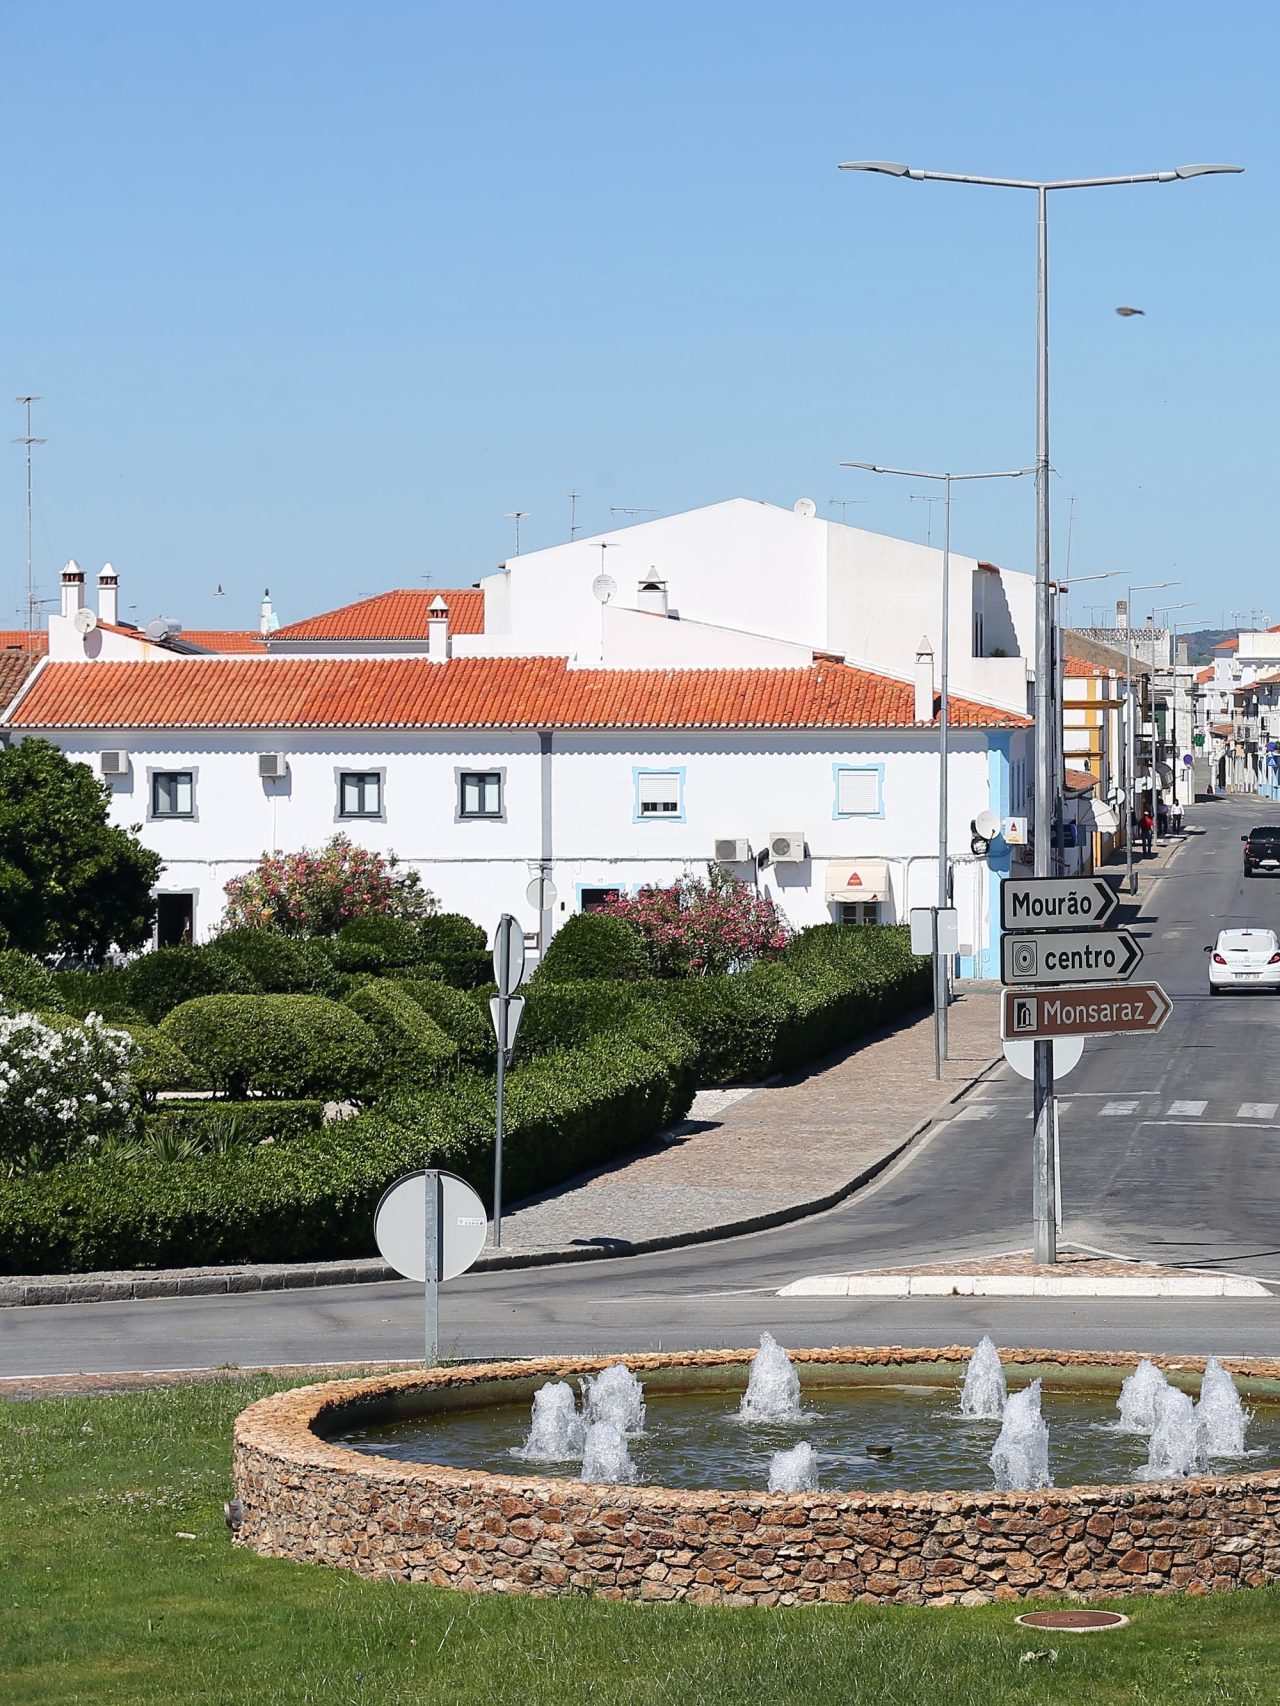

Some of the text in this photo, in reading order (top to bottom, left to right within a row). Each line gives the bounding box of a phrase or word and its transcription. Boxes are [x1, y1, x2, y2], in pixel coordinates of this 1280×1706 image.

[1012, 891, 1092, 917] Mourão
[1045, 945, 1116, 970] centro
[1043, 1000, 1144, 1025] Monsaraz
